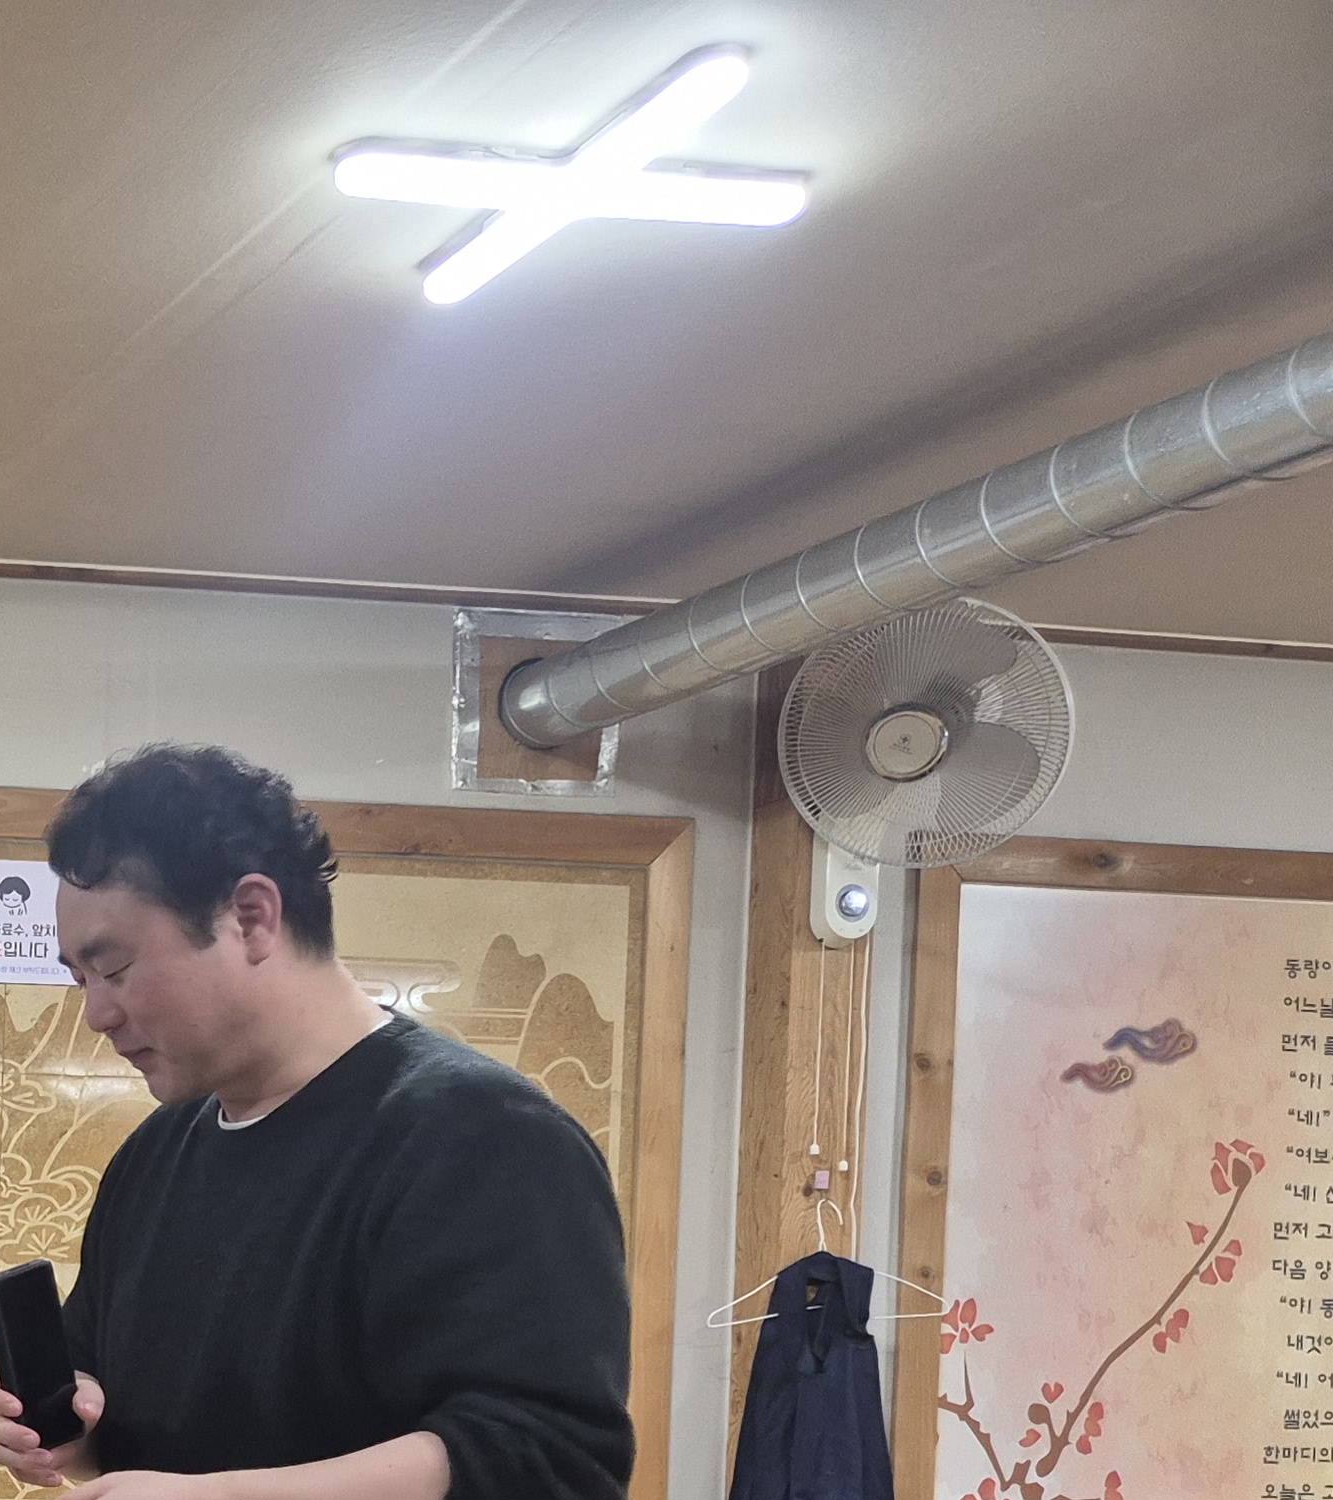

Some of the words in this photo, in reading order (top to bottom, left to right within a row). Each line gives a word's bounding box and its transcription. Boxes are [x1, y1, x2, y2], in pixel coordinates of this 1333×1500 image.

[1281, 1034, 1316, 1053] 먼저
[1274, 1222, 1308, 1240] 먼저
[1272, 1259, 1306, 1280] 다음
[1315, 1260, 1332, 1280] 양
